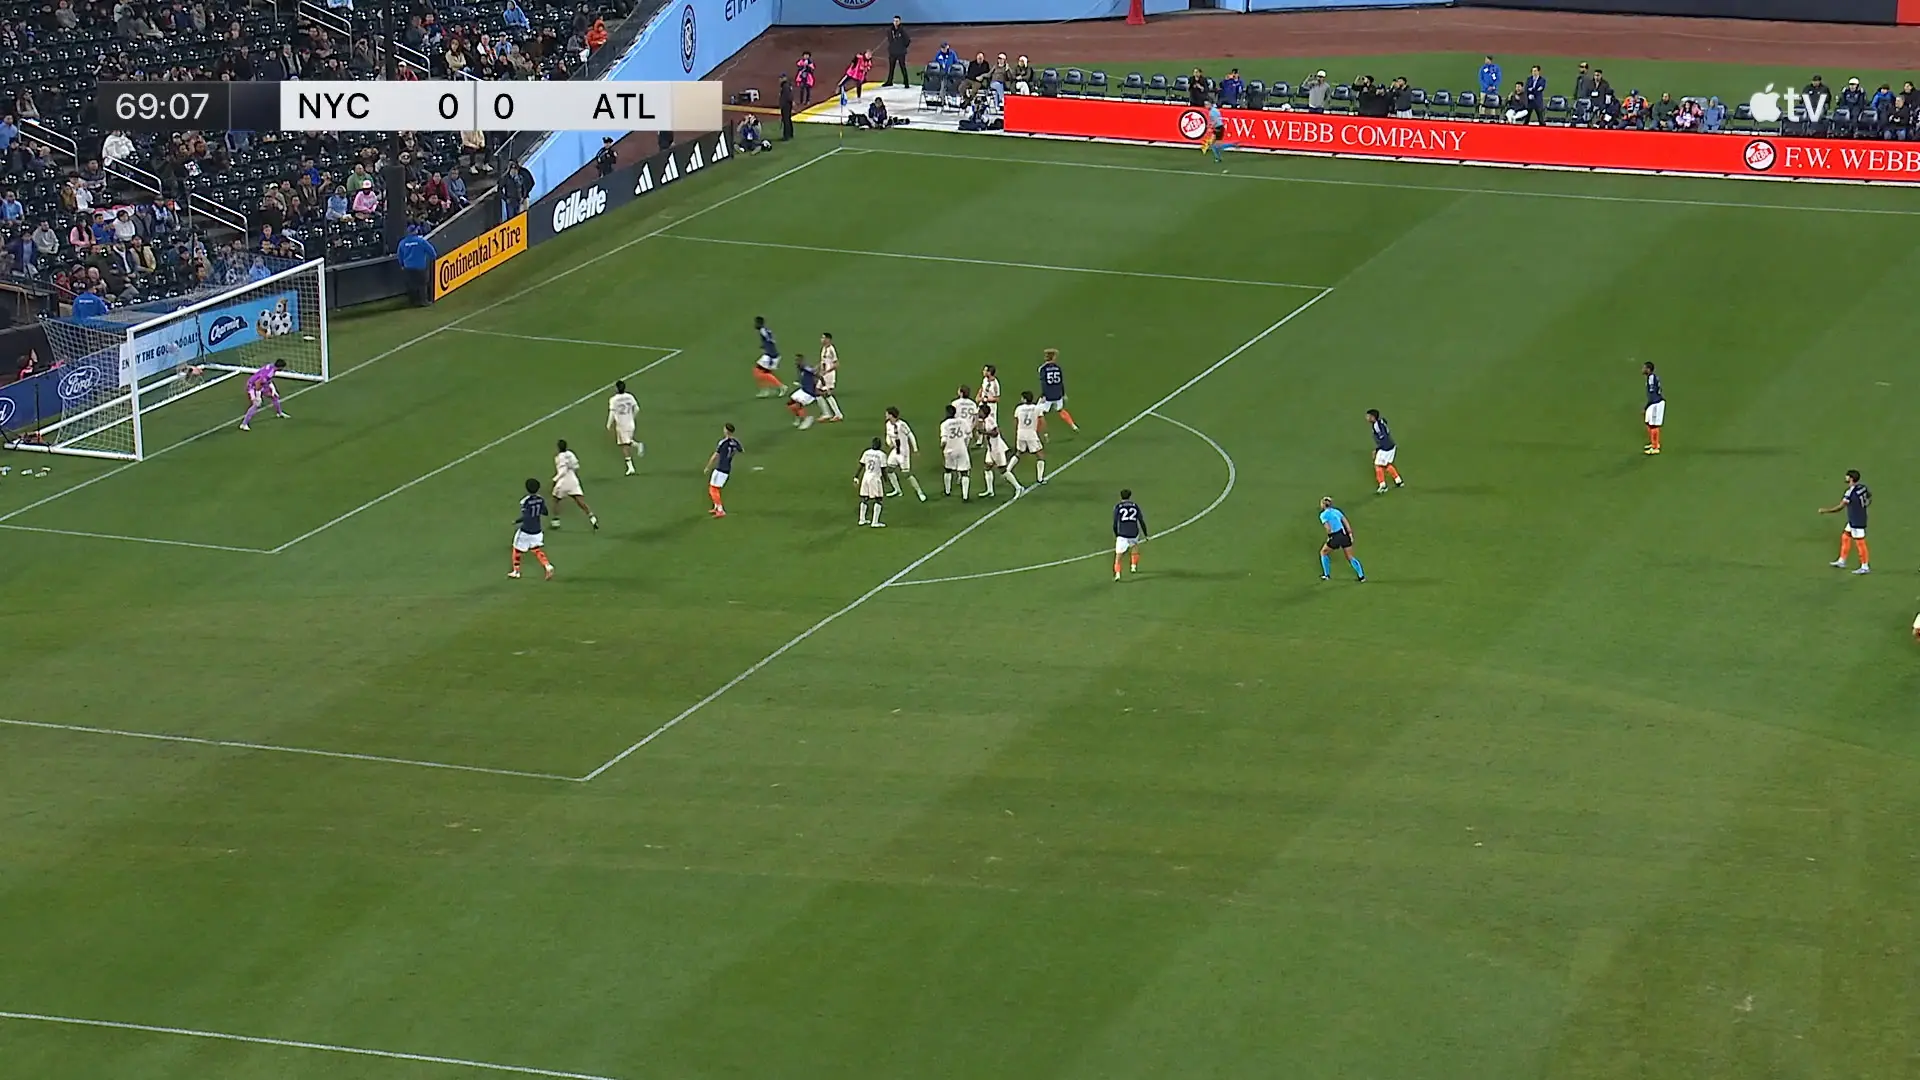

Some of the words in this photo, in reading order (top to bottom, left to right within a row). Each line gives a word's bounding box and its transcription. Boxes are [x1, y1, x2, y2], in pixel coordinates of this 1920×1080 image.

[1264, 119, 1334, 144] WEBB
[1341, 124, 1467, 151] COMPANY
[1784, 146, 1831, 170] F.W.
[1840, 148, 1920, 172] WEBB
[553, 185, 607, 233] Gillette
[440, 237, 491, 291] Continental
[500, 226, 521, 252] Tire
[211, 319, 240, 341] Charmin
[142, 348, 155, 362] THE
[66, 370, 93, 396] Ford
[1046, 371, 1061, 385] 55
[1023, 414, 1032, 426] 6
[949, 427, 963, 439] 36
[1119, 507, 1137, 521] 22
